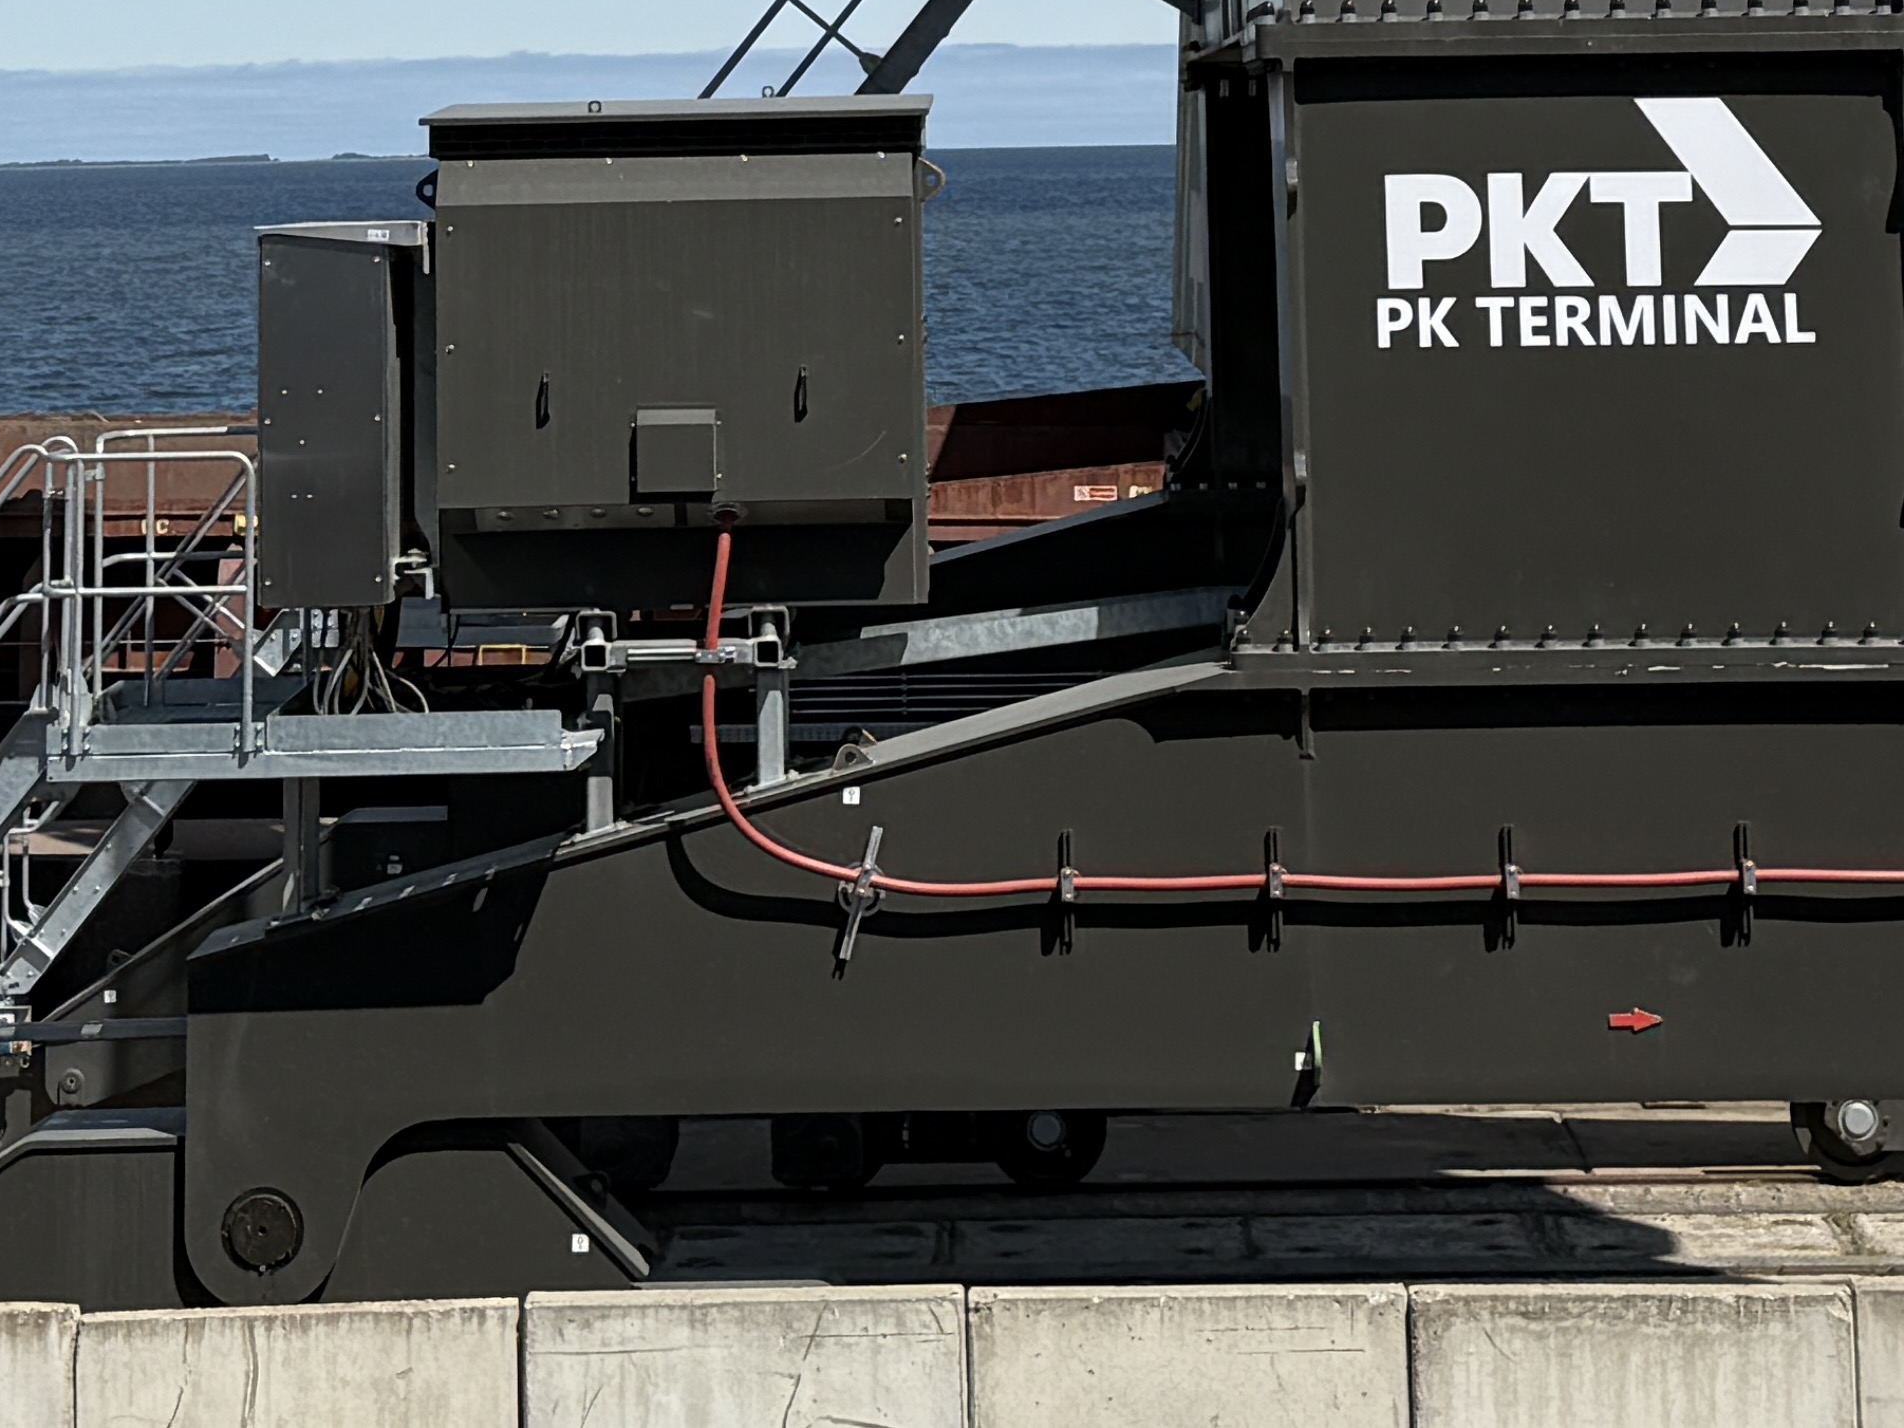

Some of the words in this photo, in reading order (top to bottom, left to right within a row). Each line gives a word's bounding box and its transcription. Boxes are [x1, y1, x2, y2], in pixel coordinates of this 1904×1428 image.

[1384, 170, 1694, 291] PKT
[1376, 295, 1459, 350] PK
[1475, 292, 1817, 349] TERMINAL
